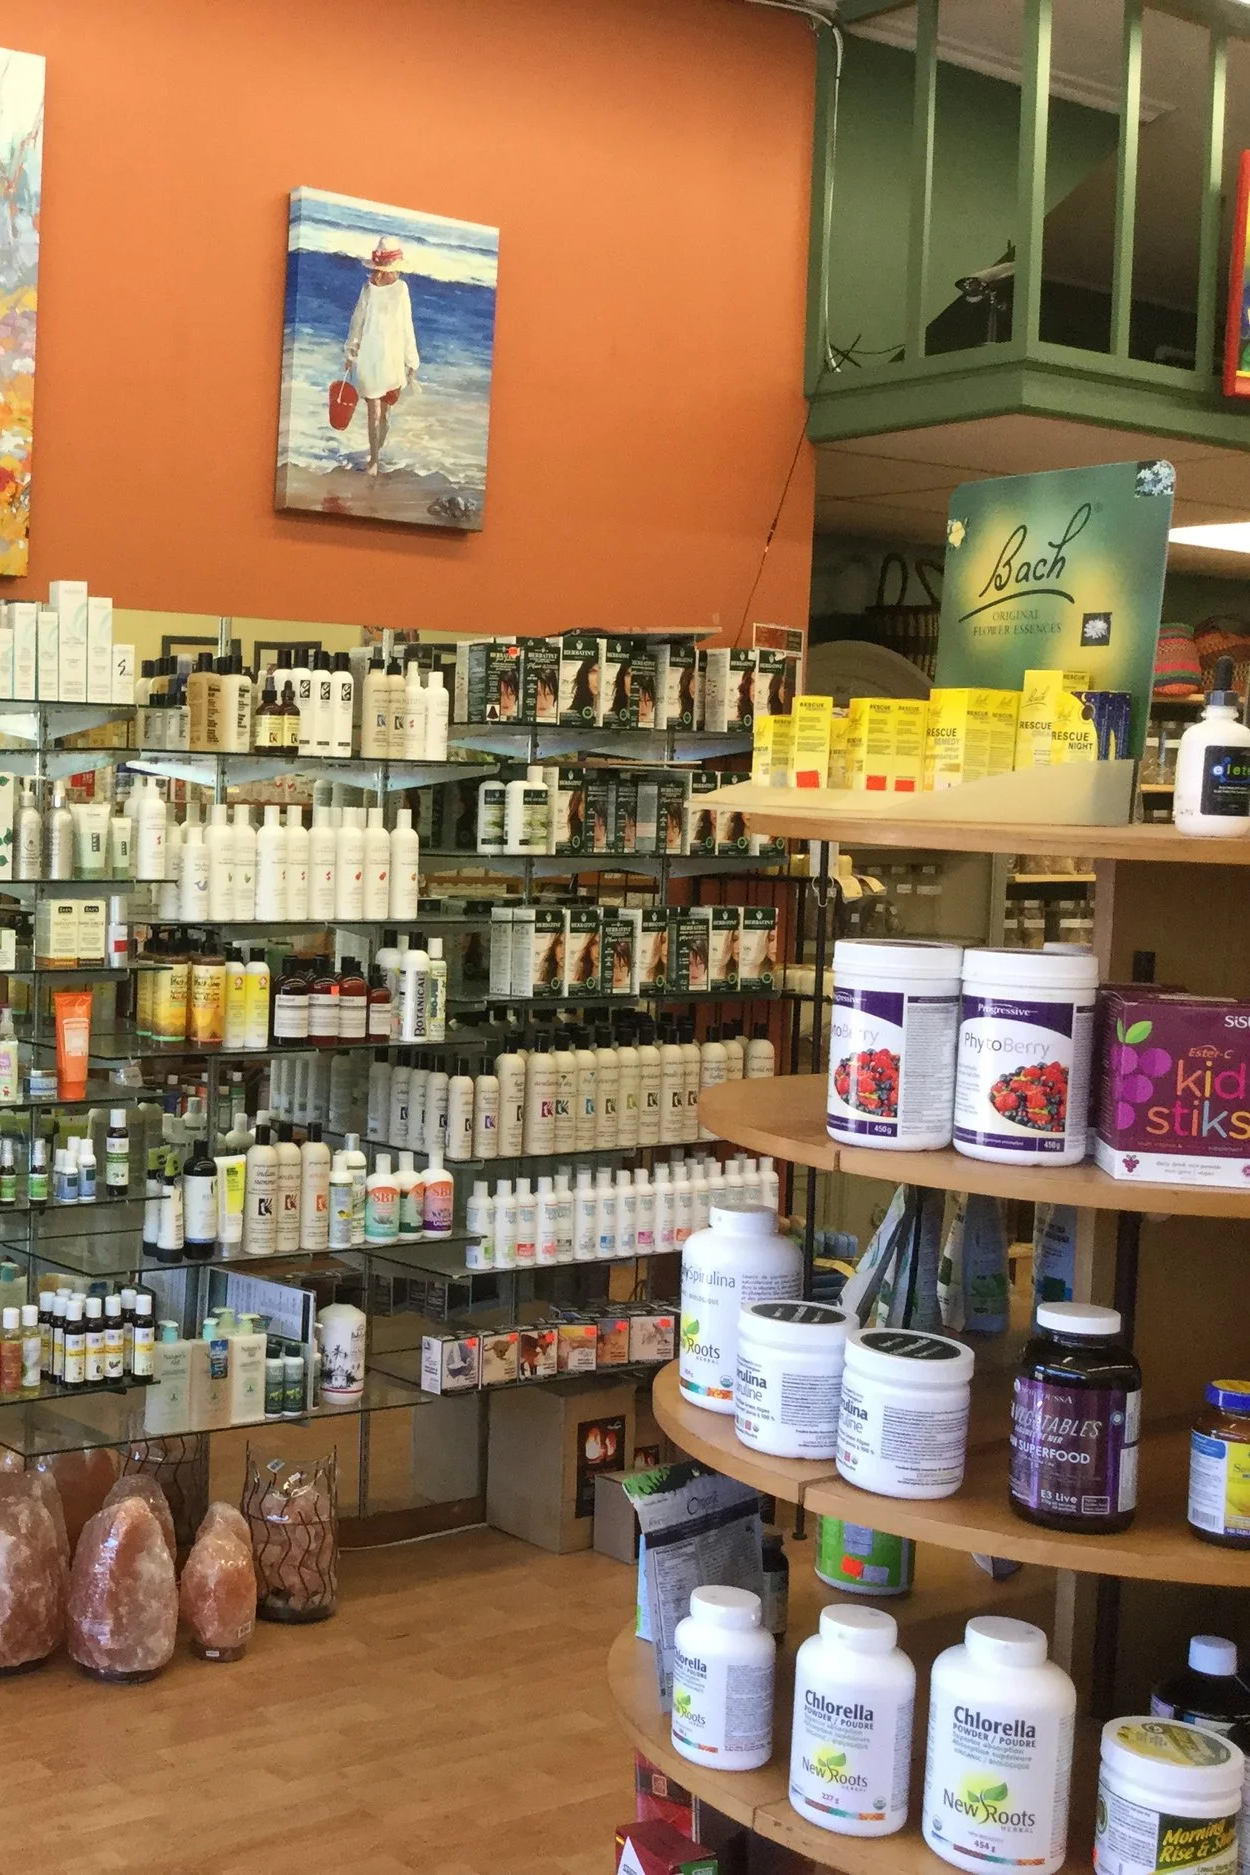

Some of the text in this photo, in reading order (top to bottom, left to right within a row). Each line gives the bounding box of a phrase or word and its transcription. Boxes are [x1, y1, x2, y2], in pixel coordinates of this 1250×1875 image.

[979, 502, 1091, 597] Bach
[992, 609, 1039, 621] ORIGINAL
[973, 622, 1062, 638] FLOWER ESSENCES
[926, 728, 957, 737] RESCUE
[1020, 721, 1052, 730] RESCUE
[1051, 731, 1089, 742] RESCUE
[1068, 742, 1093, 751] NIGHT
[414, 971, 426, 1037] BOTANICAL
[977, 1003, 1031, 1018] Progressive
[964, 1032, 1050, 1059] PhytoBerry
[1188, 1045, 1233, 1060] Ester-C
[1176, 1059, 1247, 1100] kid
[1145, 1100, 1250, 1140] stiks
[687, 1336, 721, 1360] Roots
[1019, 1441, 1090, 1465] SUPERFOOD
[1041, 1489, 1078, 1504] E3 Live
[804, 1704, 832, 1721] POWDER
[841, 1719, 874, 1730] POUDRE
[805, 1689, 874, 1721] Chlorella
[954, 1705, 1036, 1738] Chlorella
[953, 1722, 989, 1741] POWDER
[999, 1736, 1036, 1748] POUDRE
[802, 1756, 868, 1787] New Roots
[943, 1788, 1036, 1827] New Roots
[1162, 1819, 1227, 1846] Morning
[974, 1840, 990, 1850] 454
[1159, 1846, 1194, 1863] Rise
